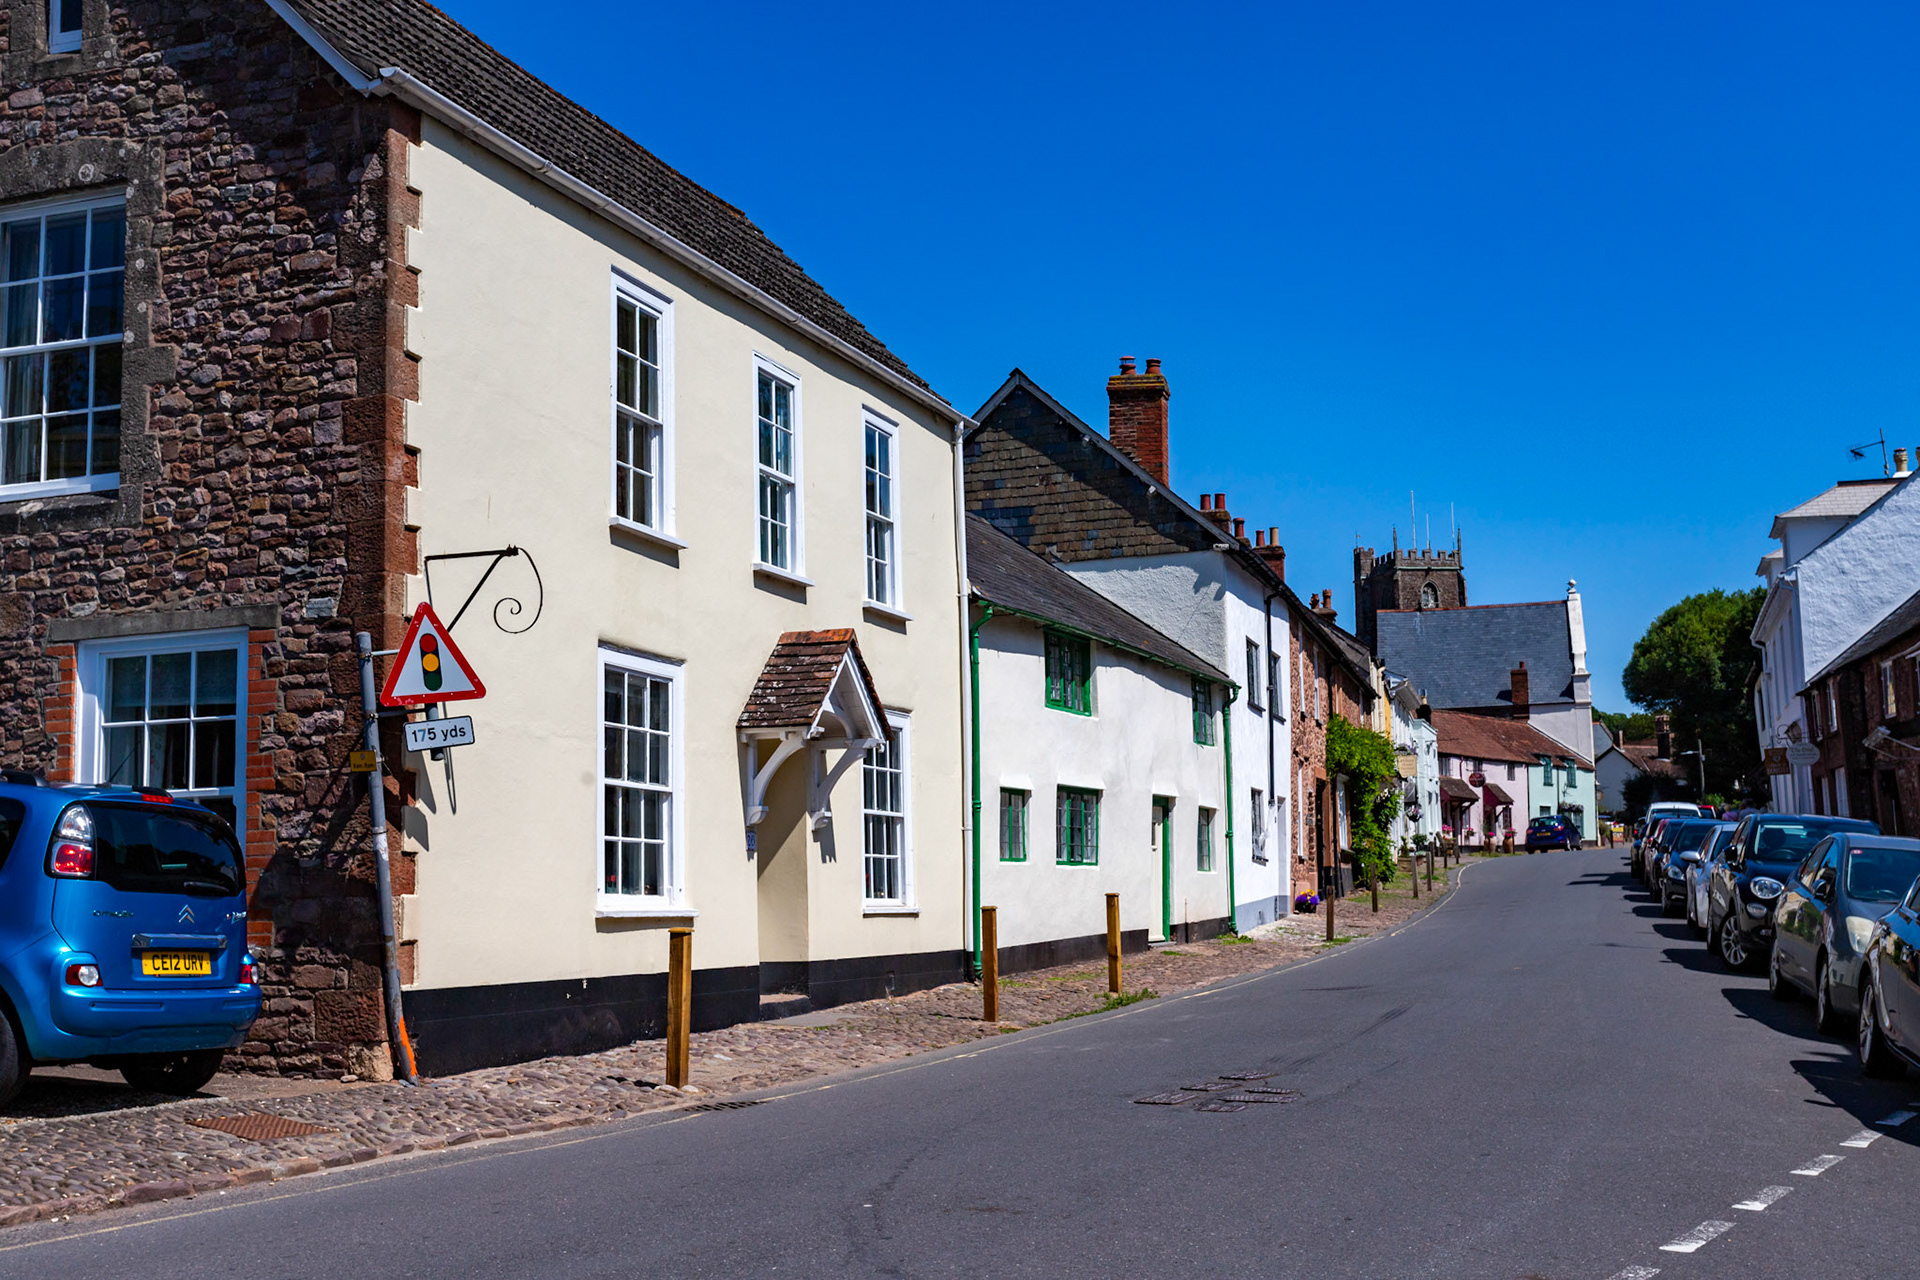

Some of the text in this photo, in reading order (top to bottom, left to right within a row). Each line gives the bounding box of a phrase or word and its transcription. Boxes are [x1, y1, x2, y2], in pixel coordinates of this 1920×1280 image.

[411, 725, 467, 743] 175 yds
[151, 954, 204, 971] CE12 URV
